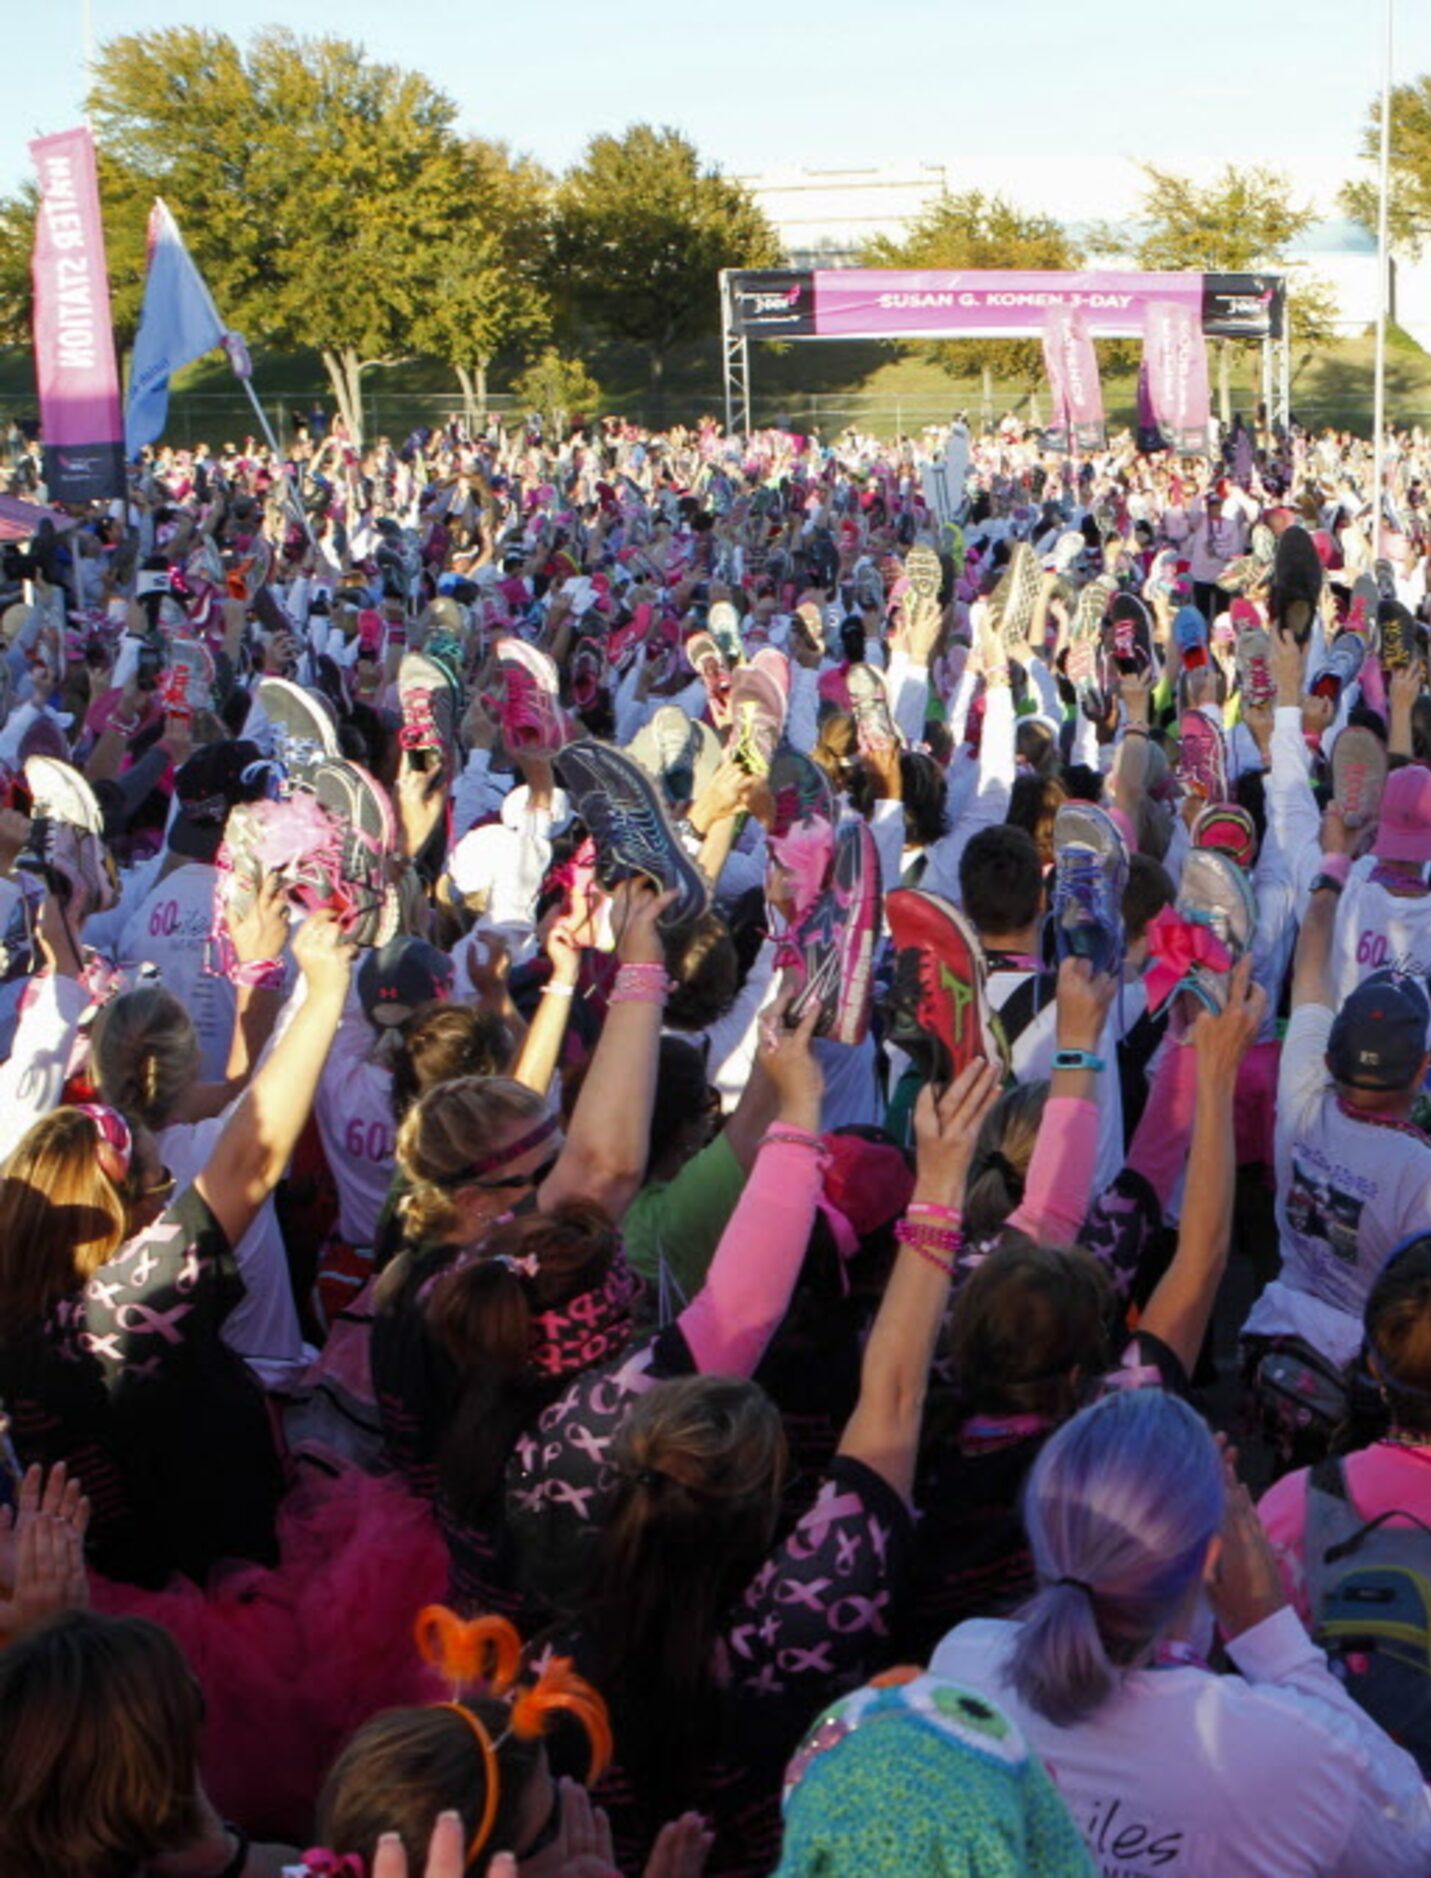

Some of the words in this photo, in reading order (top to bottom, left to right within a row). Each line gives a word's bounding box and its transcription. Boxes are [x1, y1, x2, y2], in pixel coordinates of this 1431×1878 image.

[879, 293, 954, 308] SUSAN
[958, 293, 981, 306] G.
[986, 293, 1063, 307] KOMEN
[1069, 294, 1133, 309] 3-DAY
[149, 899, 178, 936] 60
[1356, 929, 1388, 968] 60
[346, 1117, 387, 1163] 60
[1086, 1798, 1183, 1867] iles
